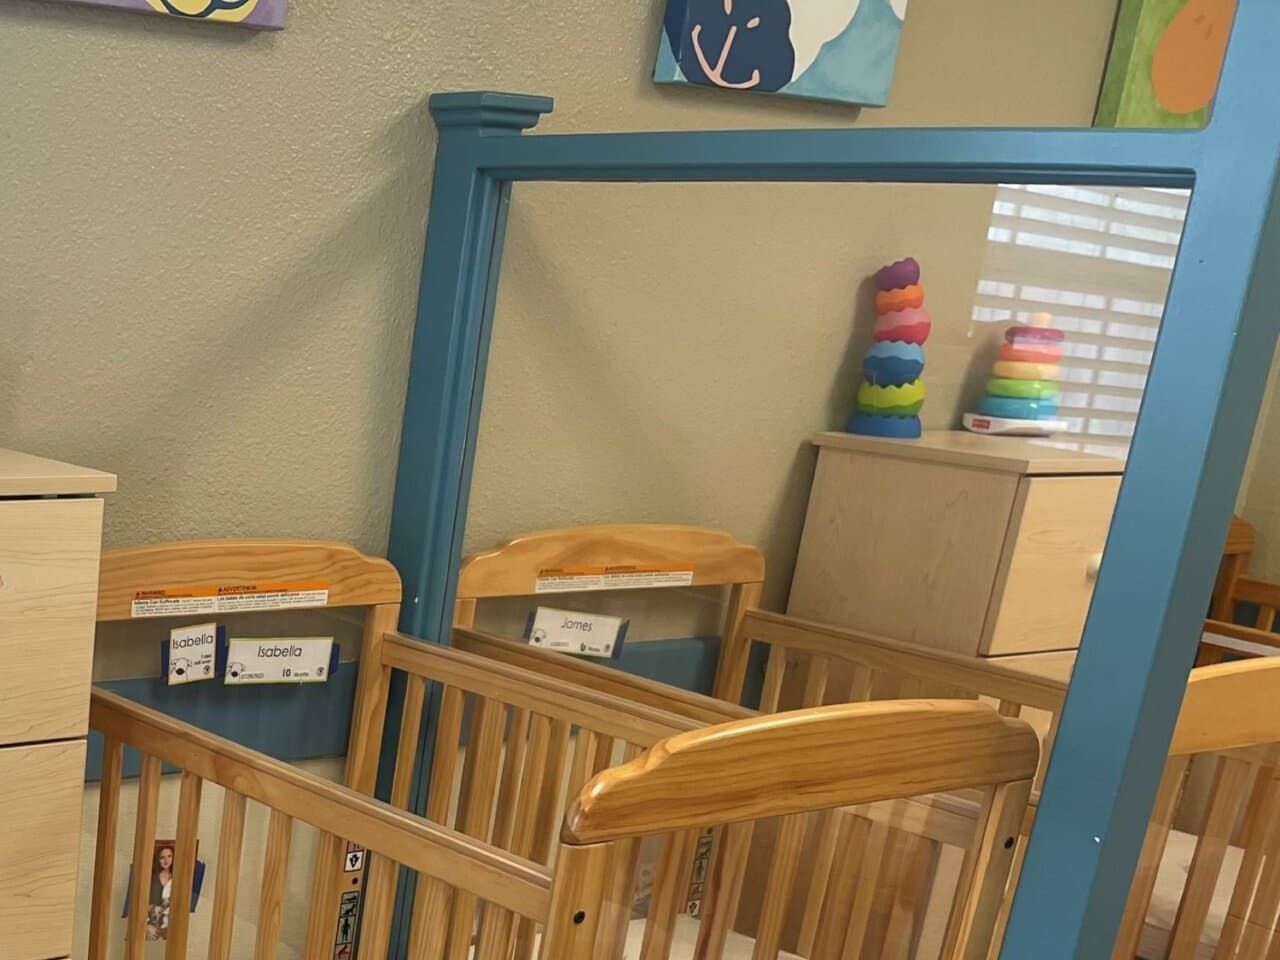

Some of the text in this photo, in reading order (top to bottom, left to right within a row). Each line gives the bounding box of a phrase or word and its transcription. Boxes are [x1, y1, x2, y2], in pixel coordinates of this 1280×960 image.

[561, 616, 593, 632] James
[172, 633, 214, 650] Isabella
[257, 645, 303, 658] Isabella
